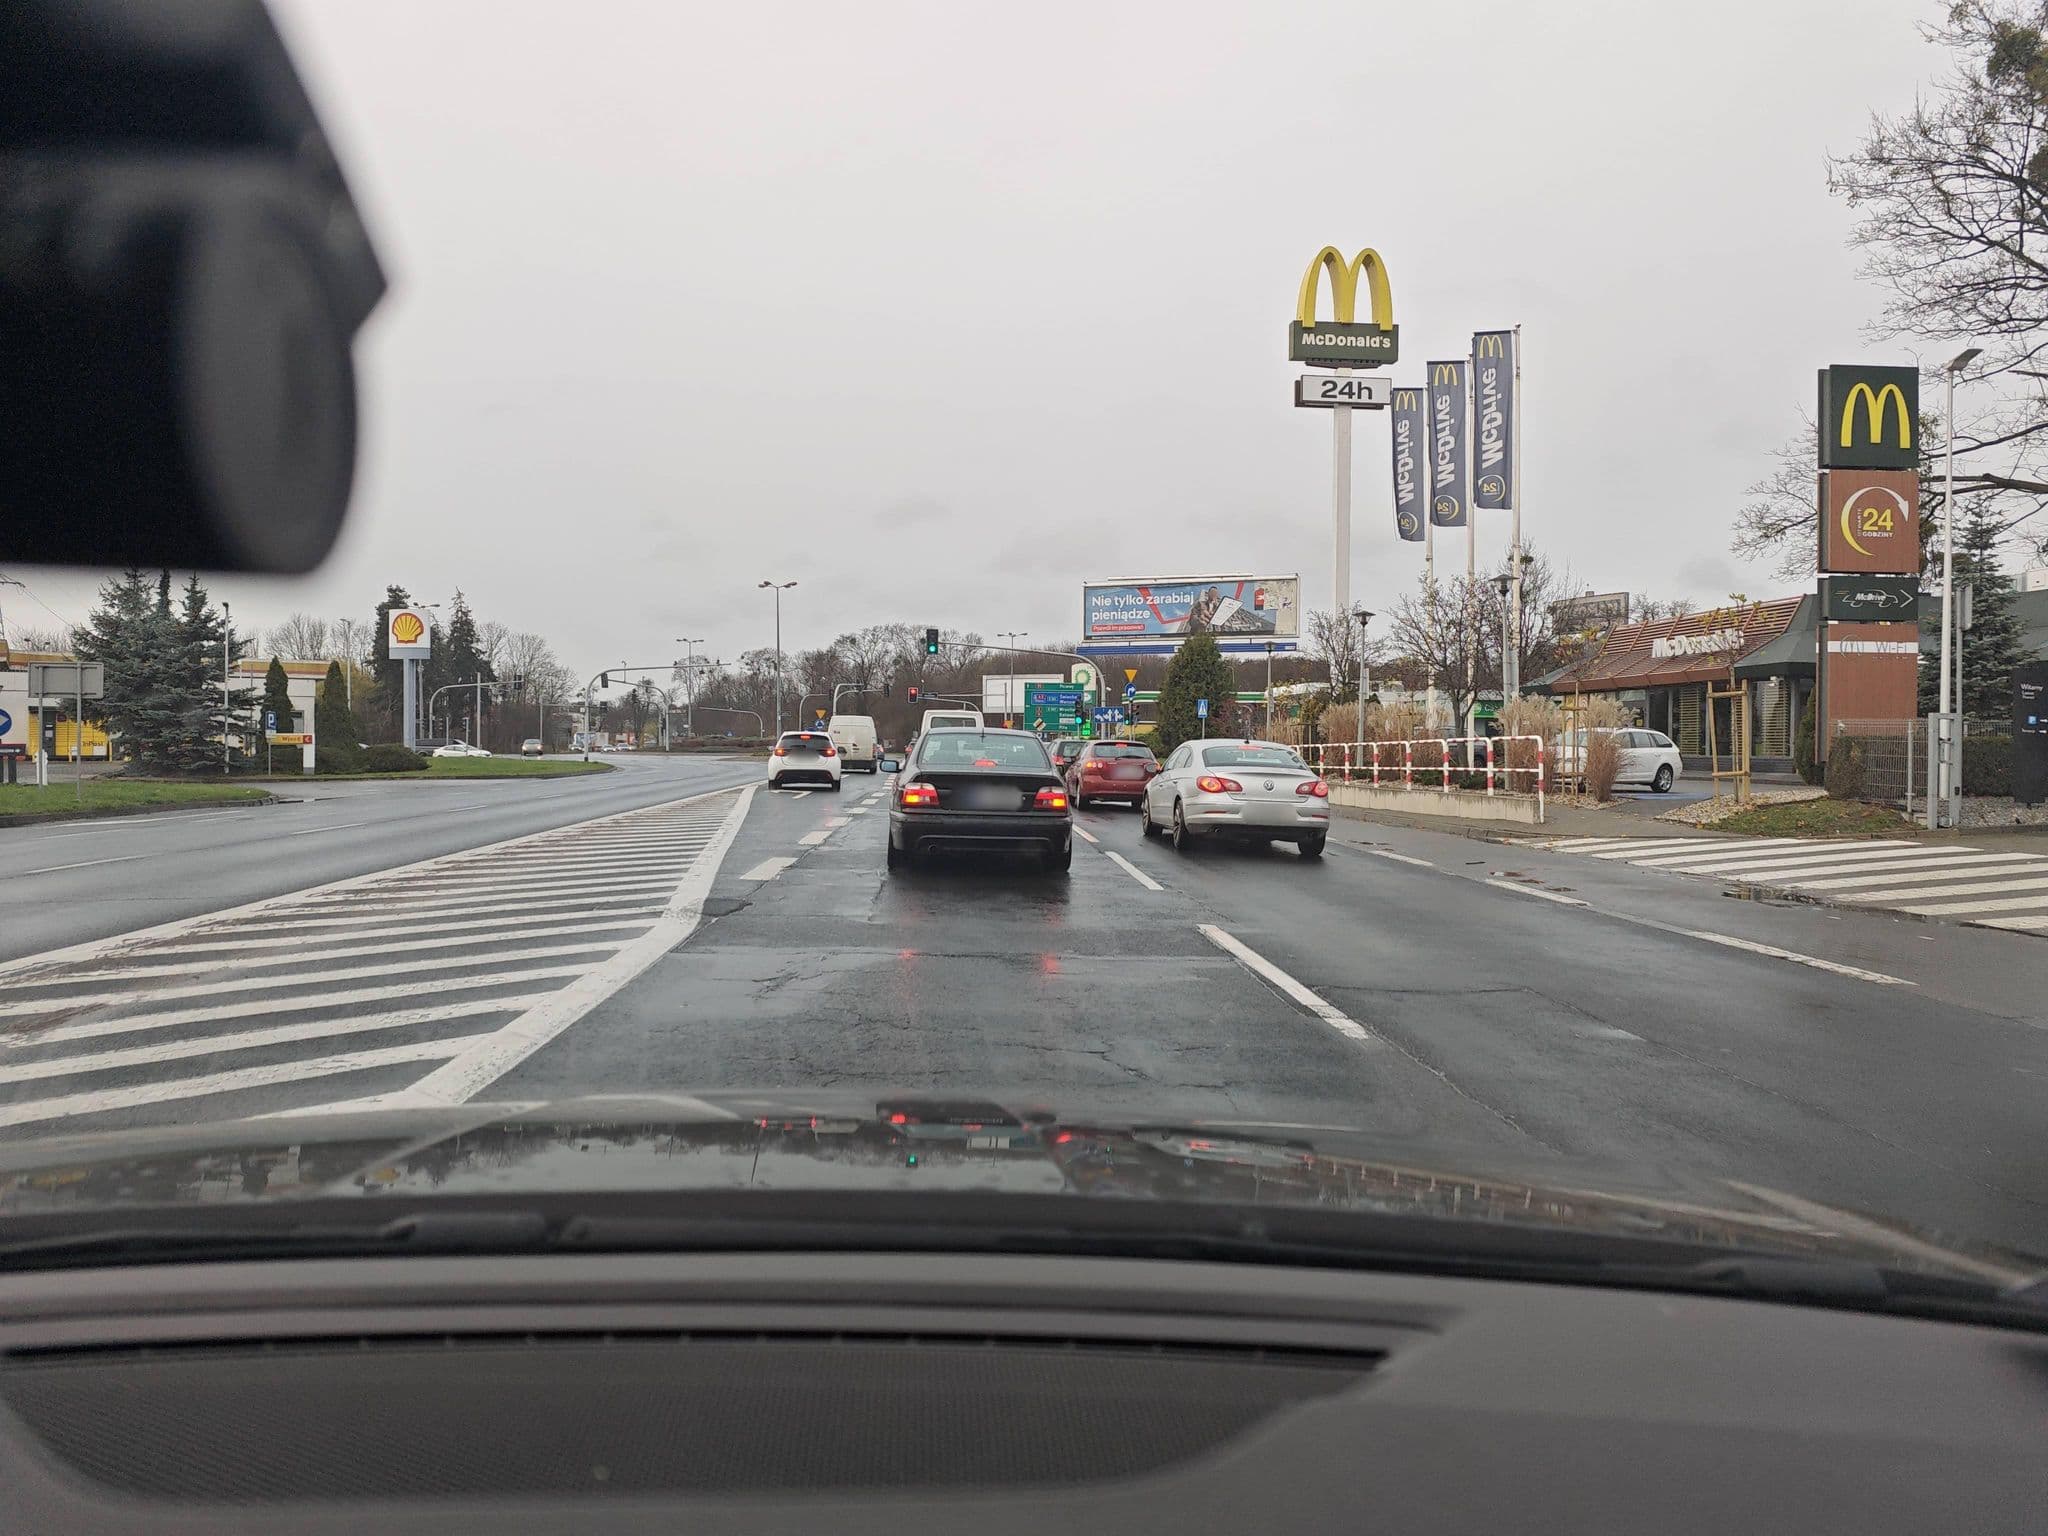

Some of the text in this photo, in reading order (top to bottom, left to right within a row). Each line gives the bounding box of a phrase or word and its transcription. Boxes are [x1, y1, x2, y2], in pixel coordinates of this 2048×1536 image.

[1301, 332, 1391, 349] McDonald's
[1320, 380, 1373, 400] 24h
[1862, 507, 1894, 531] 24
[1092, 592, 1194, 608] Nie tylko zarabiaj
[1855, 592, 1887, 602] McDrive
[1092, 609, 1151, 623] pieniądze
